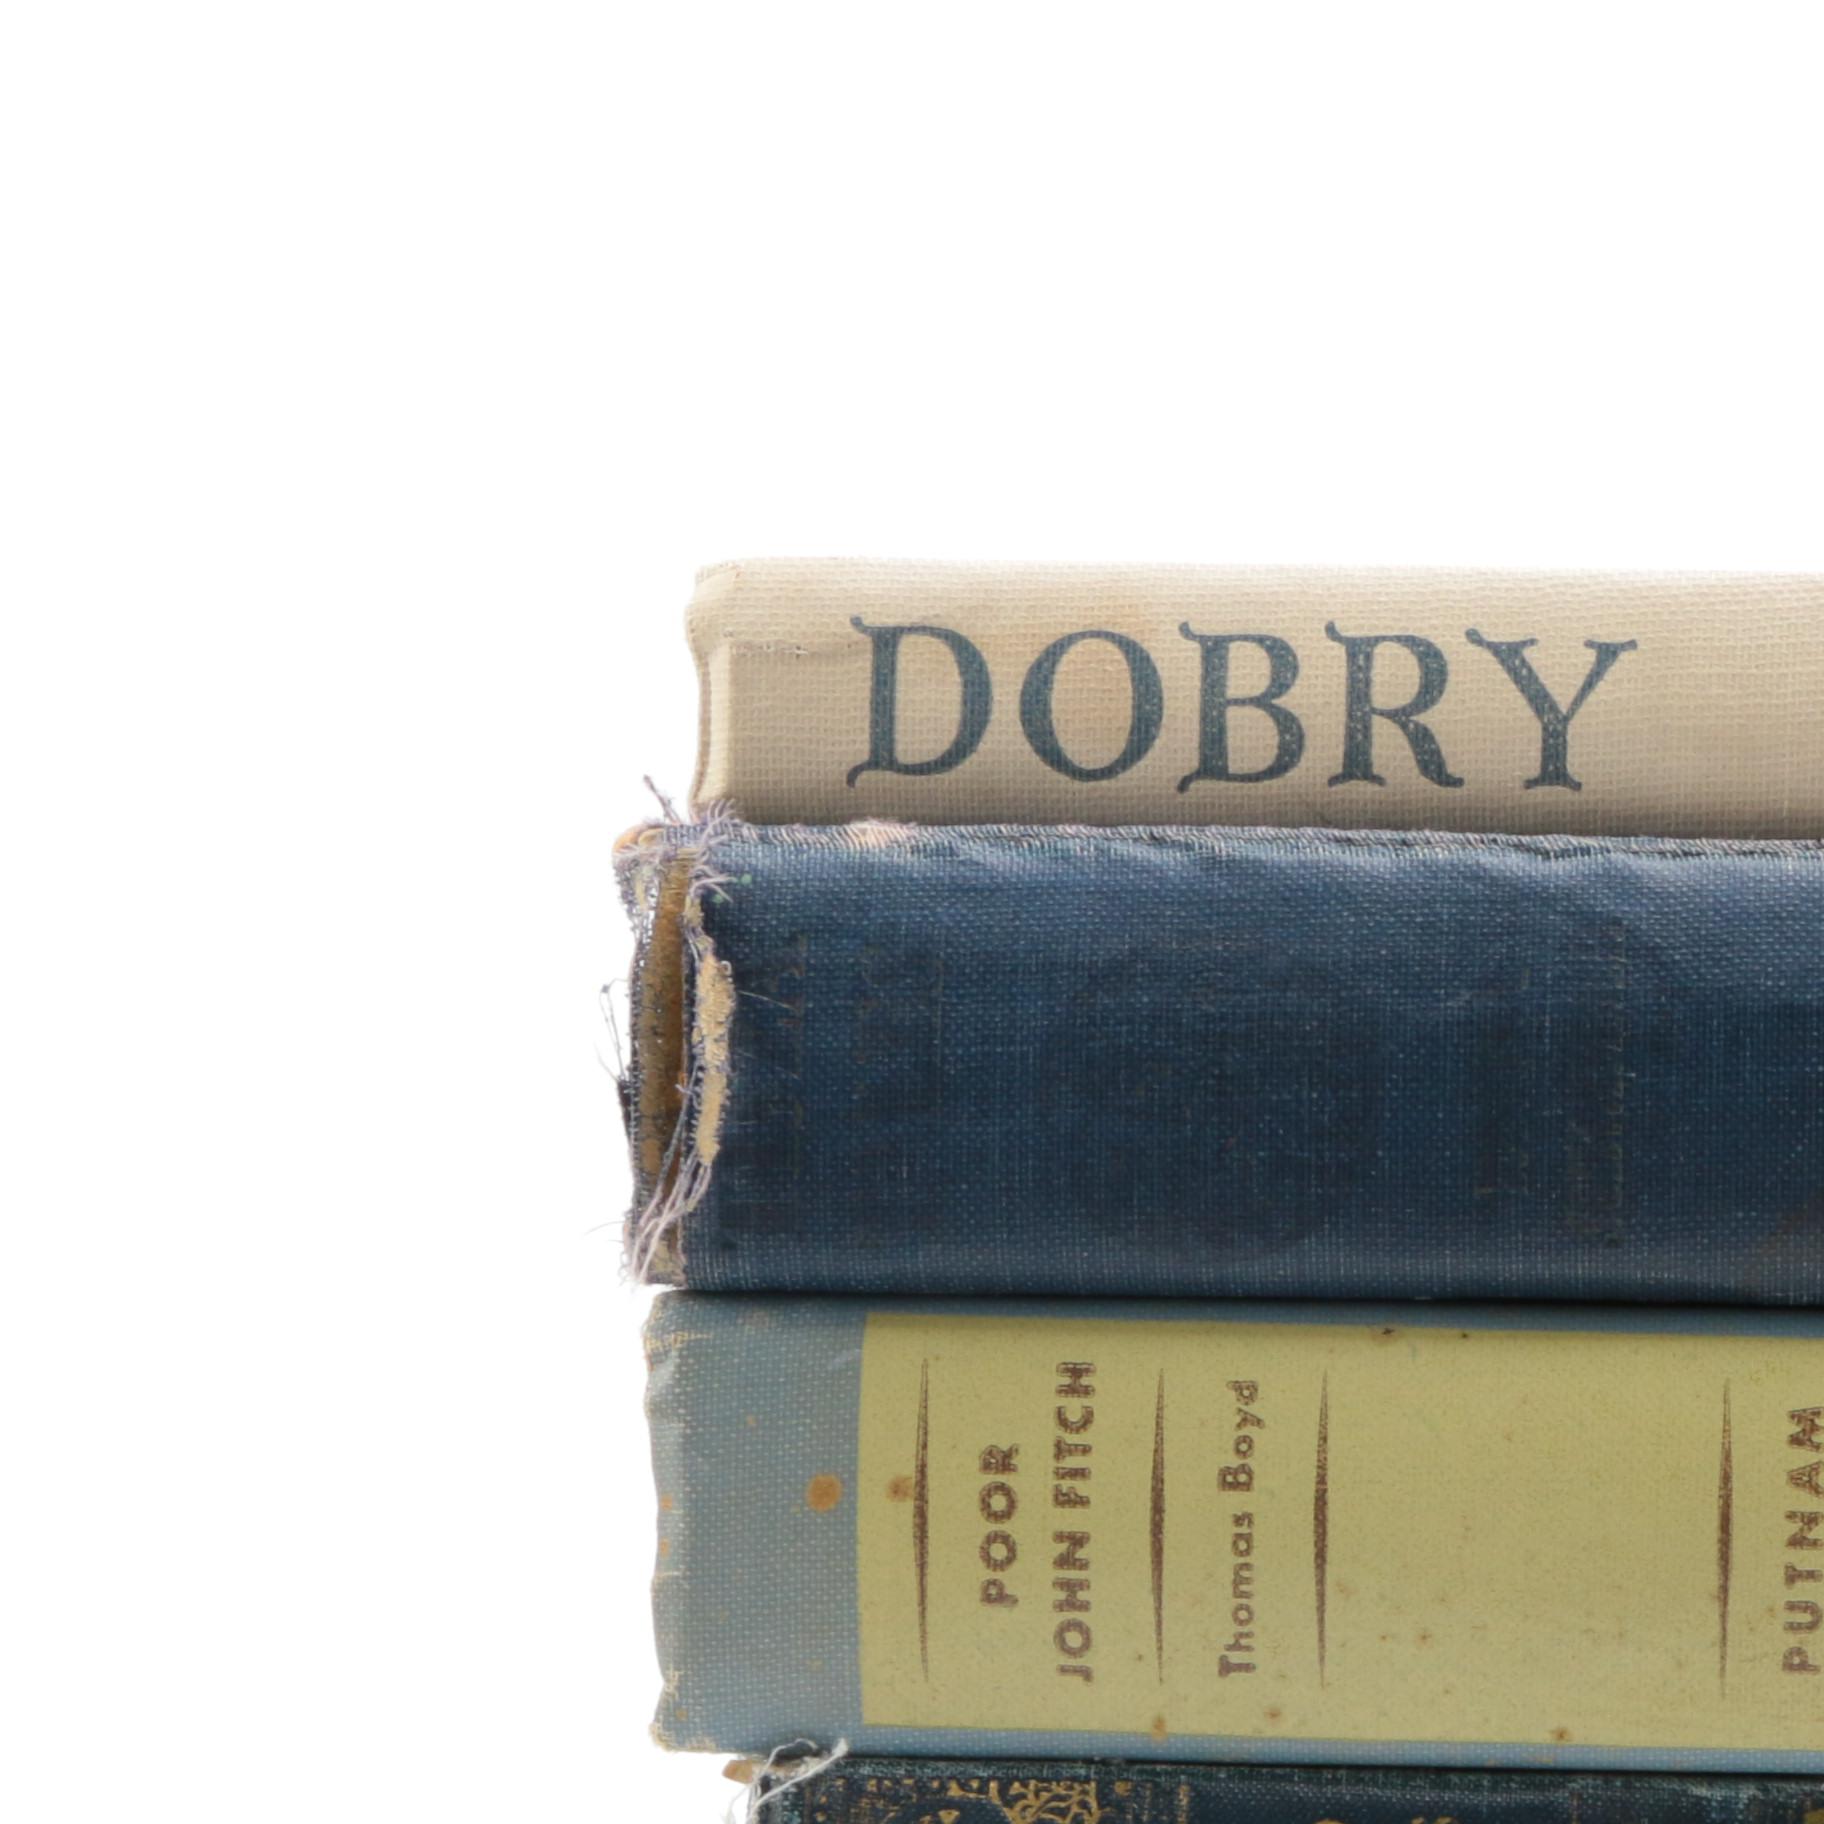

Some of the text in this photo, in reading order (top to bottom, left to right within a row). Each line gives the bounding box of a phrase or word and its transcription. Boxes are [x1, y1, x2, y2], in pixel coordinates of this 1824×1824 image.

[846, 615, 1639, 796] DOBRY
[979, 1443, 1019, 1608] POOR
[1053, 1361, 1096, 1684] JOHN FITCH
[1217, 1380, 1266, 1678] Thomas Boyd
